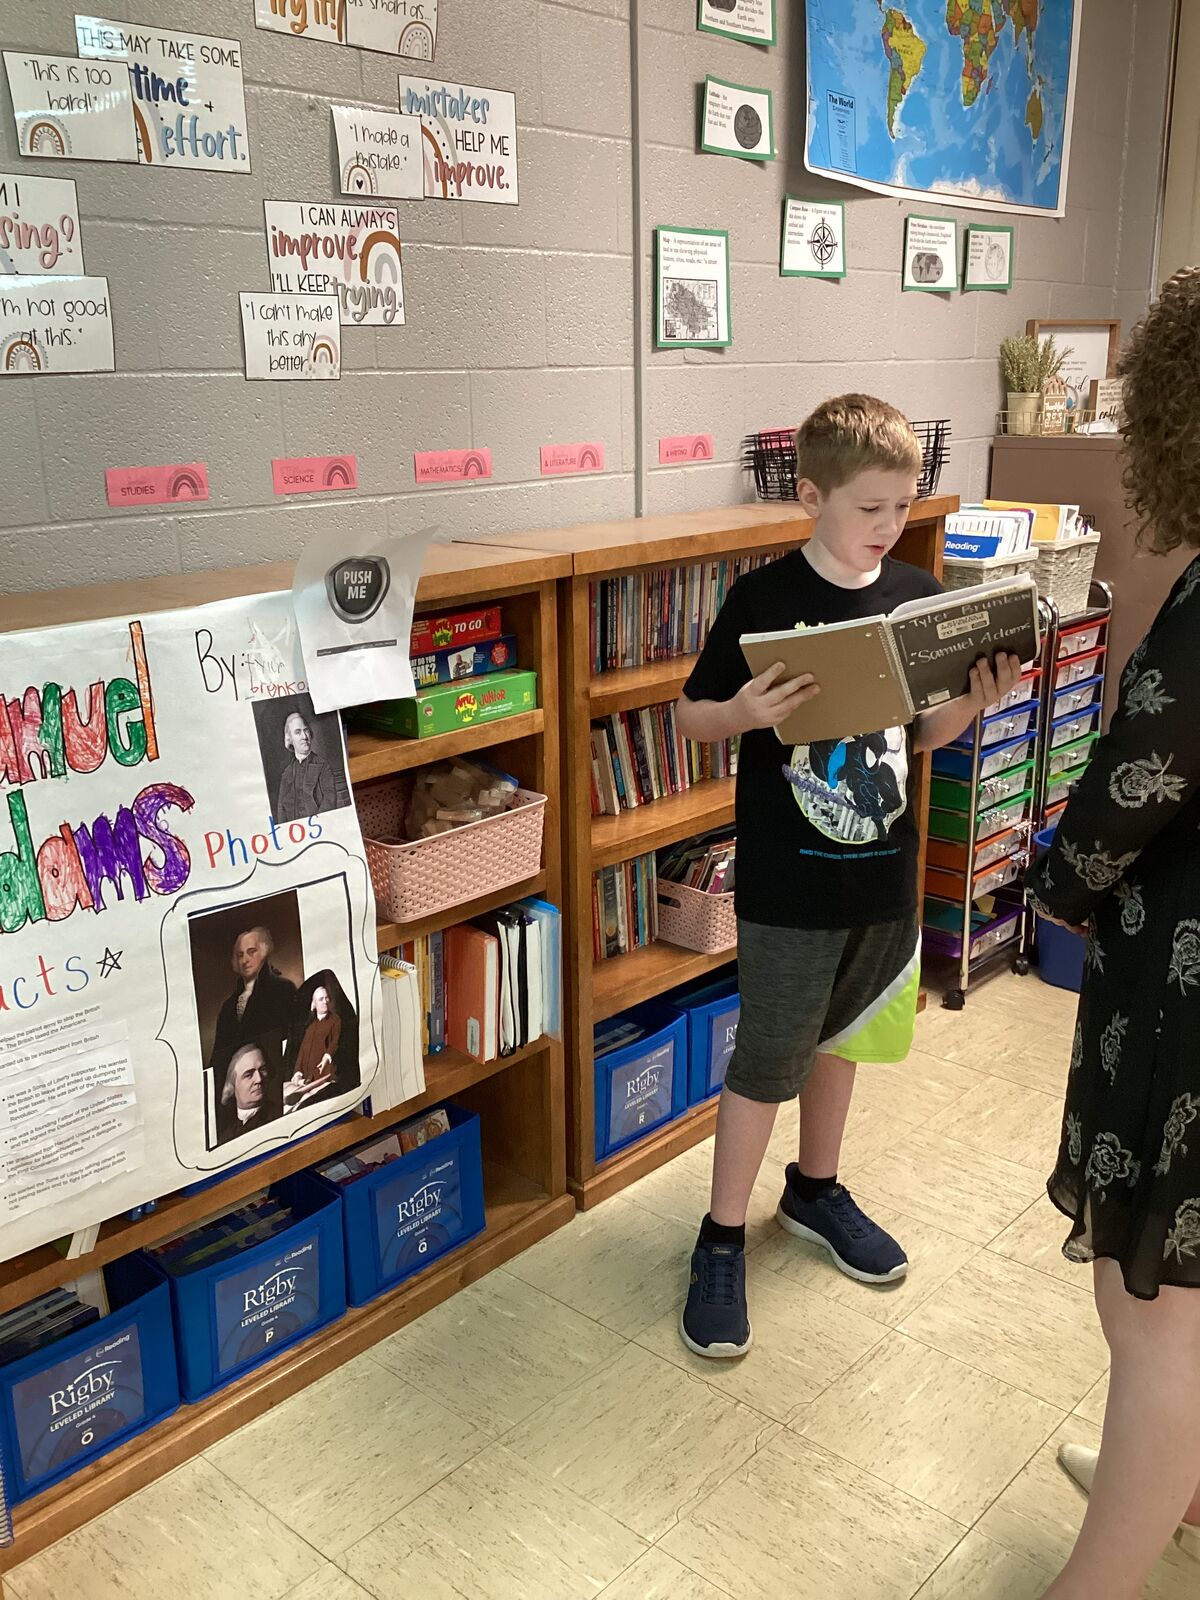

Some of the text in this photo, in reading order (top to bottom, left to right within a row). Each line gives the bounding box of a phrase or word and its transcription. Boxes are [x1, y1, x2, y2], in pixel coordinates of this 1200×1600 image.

[78, 26, 240, 68] THIS MAY TAKE SOME
[66, 65, 79, 83] is
[85, 67, 112, 85] too
[129, 62, 190, 107] time
[406, 85, 489, 124] mistakes
[829, 94, 854, 109] The World
[162, 113, 246, 160] effort.
[362, 127, 398, 144] made
[401, 133, 409, 147] a
[455, 130, 510, 157] HELP ME
[434, 153, 510, 197] improve.
[300, 206, 395, 229] I CAN ALWAYS
[271, 225, 363, 271] improve.
[272, 273, 330, 292] I'LL KEEP
[26, 297, 55, 316] not
[63, 296, 108, 323] good
[259, 304, 291, 321] can't
[296, 304, 333, 322] make
[267, 329, 317, 350] this any
[269, 354, 308, 372] better
[283, 474, 315, 485] SCIENCE
[420, 465, 462, 474] MATHEMATICS
[120, 485, 156, 497] STUDIES
[945, 540, 979, 552] Reading
[343, 570, 373, 586] PUSH
[347, 585, 367, 600] ME
[454, 622, 466, 634] TO
[468, 619, 482, 631] GO
[411, 663, 436, 680] EME?
[480, 688, 506, 707] JUNIOR
[204, 814, 323, 869] Photos
[627, 1071, 660, 1097] Rigby
[624, 1097, 642, 1110] LEVELED
[642, 1088, 659, 1101] LIBRARY
[397, 1188, 441, 1223] Rigby
[396, 1207, 442, 1238] LEVELED LIBRARY
[418, 1241, 428, 1253] Q
[243, 1275, 297, 1312] Rigby
[241, 1295, 296, 1328] LEVELED LIBRARY
[265, 1331, 274, 1343] P
[48, 1368, 115, 1416] Rigby
[50, 1390, 116, 1432] LEVELED LIBRARY
